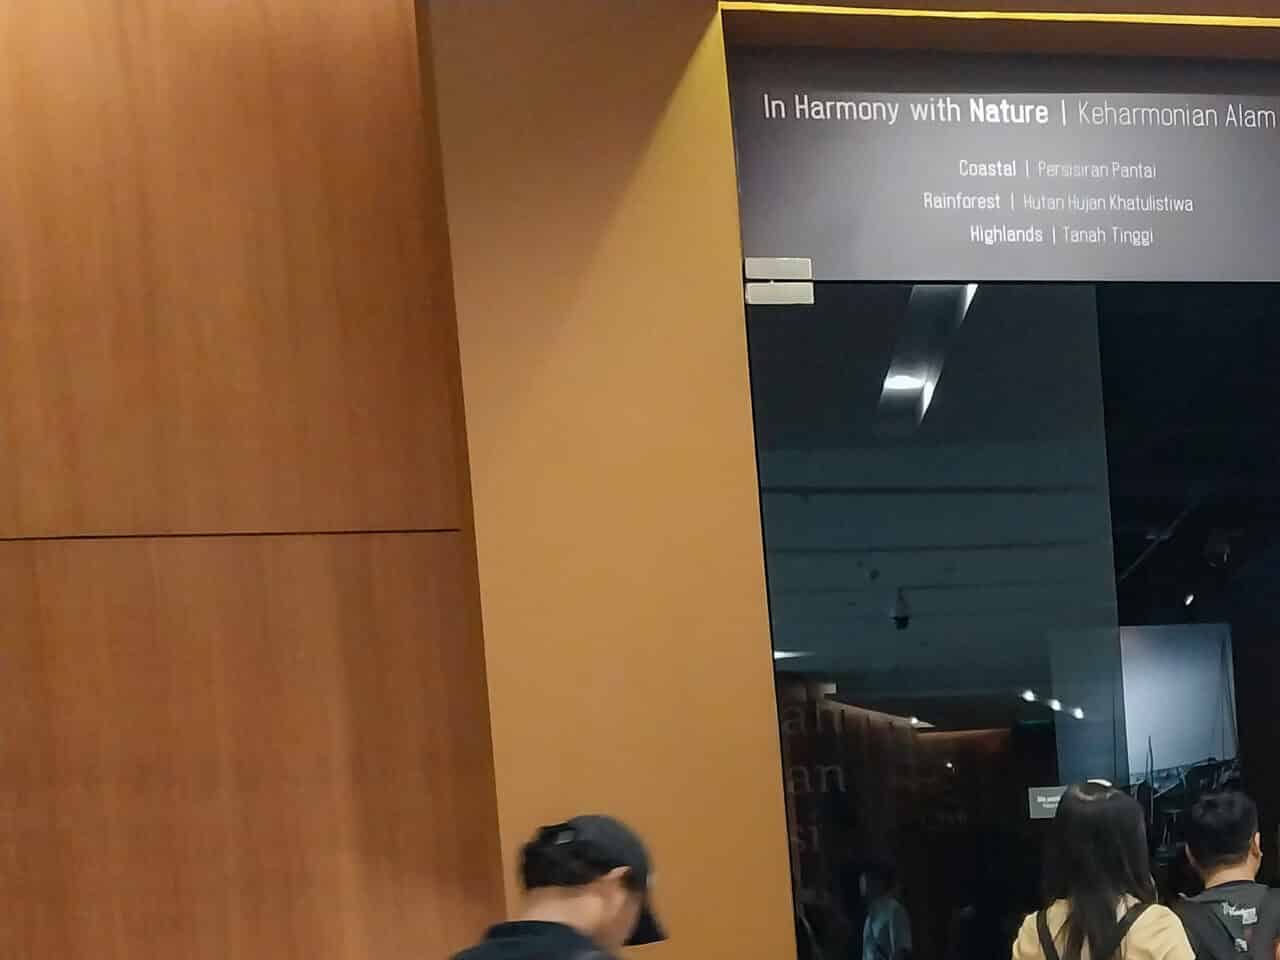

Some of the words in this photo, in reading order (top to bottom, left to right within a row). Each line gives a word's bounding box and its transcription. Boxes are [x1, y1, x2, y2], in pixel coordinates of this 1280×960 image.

[763, 94, 786, 119] In
[795, 94, 899, 125] Harmony
[910, 97, 961, 122] with
[969, 98, 1049, 124] Nature
[1078, 100, 1218, 128] Keharmonian
[1225, 103, 1276, 129] Alam
[959, 160, 1017, 177] Coastal
[1112, 161, 1157, 179] Pantai
[923, 192, 1001, 210] Rainforest
[1023, 193, 1065, 211] Hutan
[1068, 194, 1106, 213] Hujan
[1109, 193, 1194, 212] Khatulistiwa
[970, 225, 1043, 245] Highlands
[1063, 226, 1106, 243] Tanah
[1111, 226, 1154, 246] Tinggi
